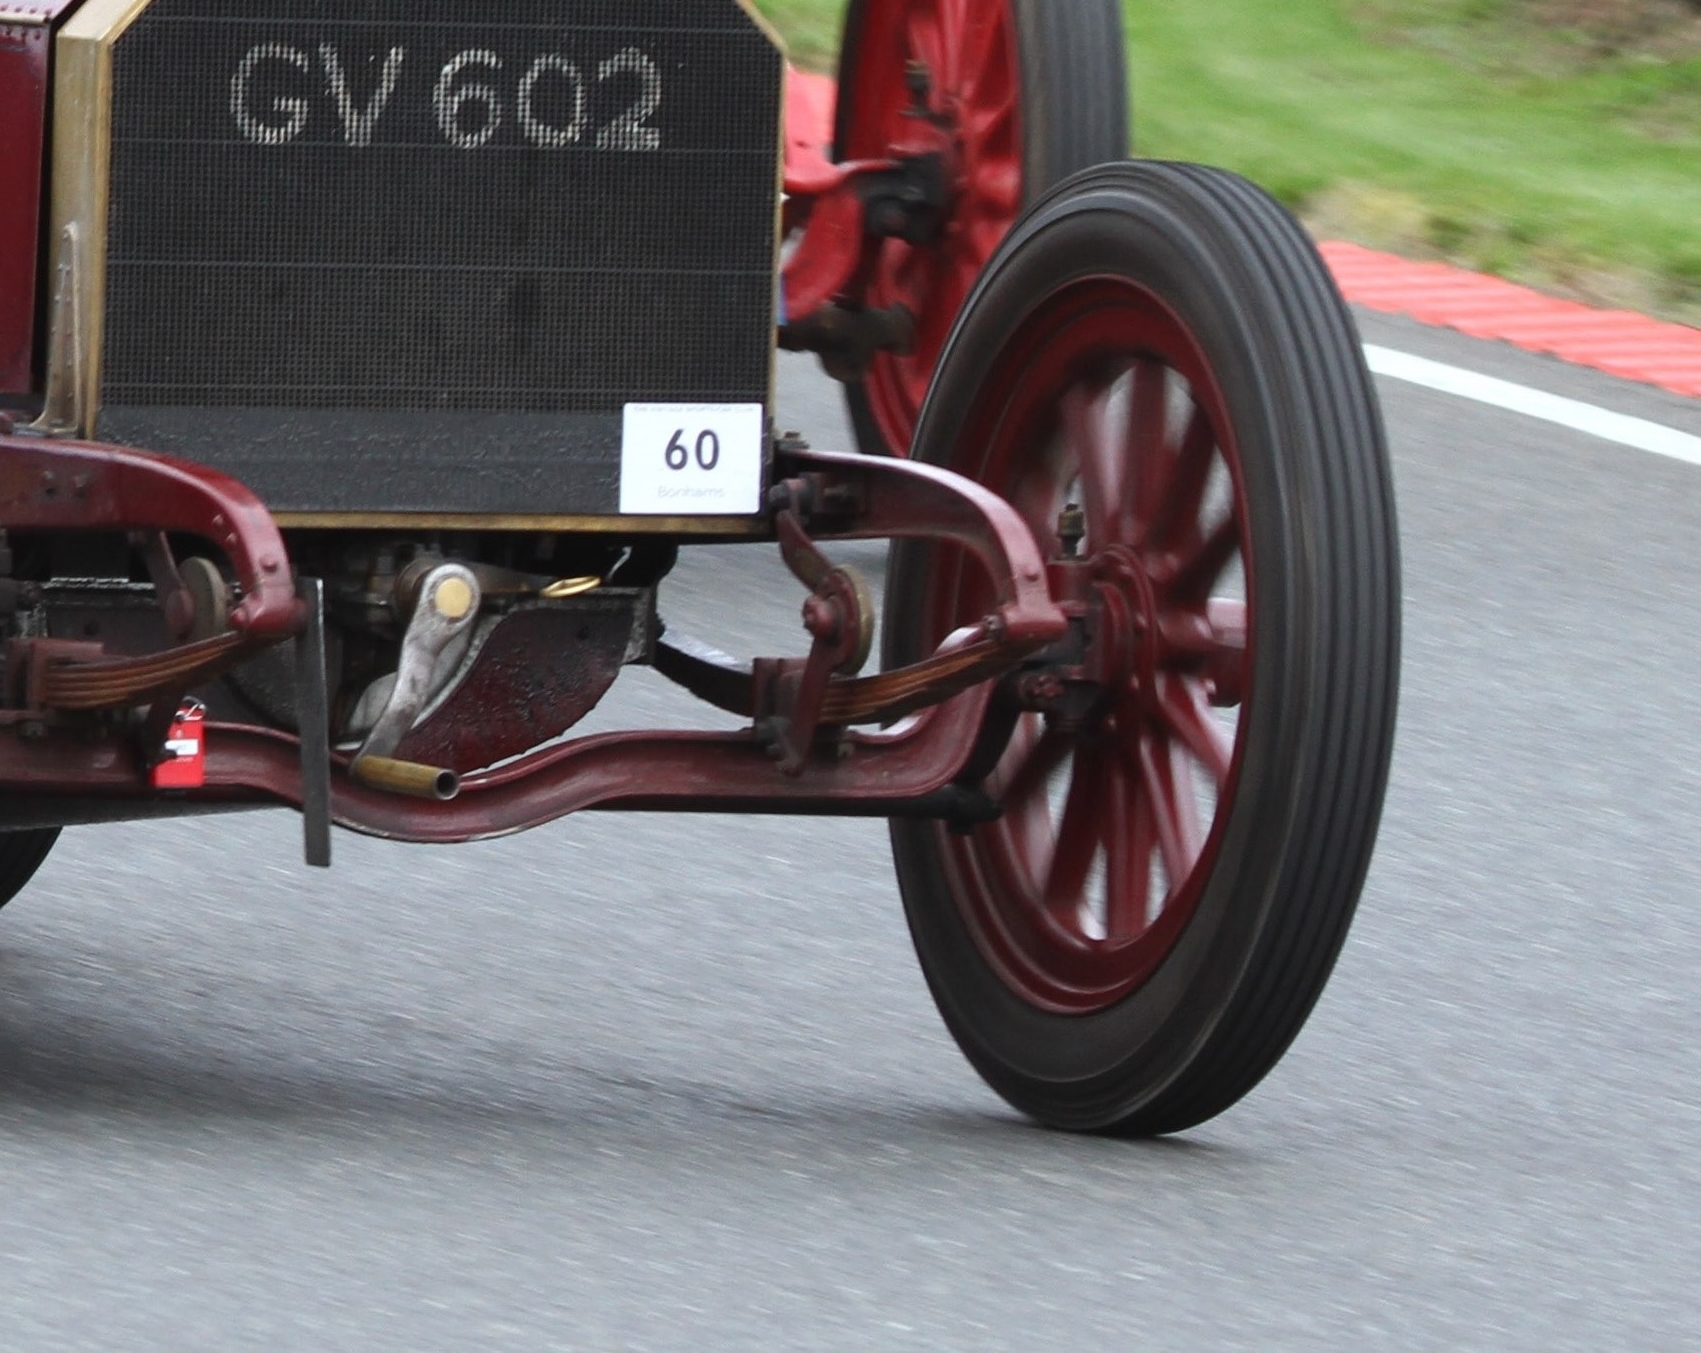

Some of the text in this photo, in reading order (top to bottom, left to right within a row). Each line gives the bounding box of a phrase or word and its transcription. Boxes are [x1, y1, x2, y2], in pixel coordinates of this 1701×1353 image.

[230, 42, 661, 150] GV 602
[664, 428, 720, 471] 60
